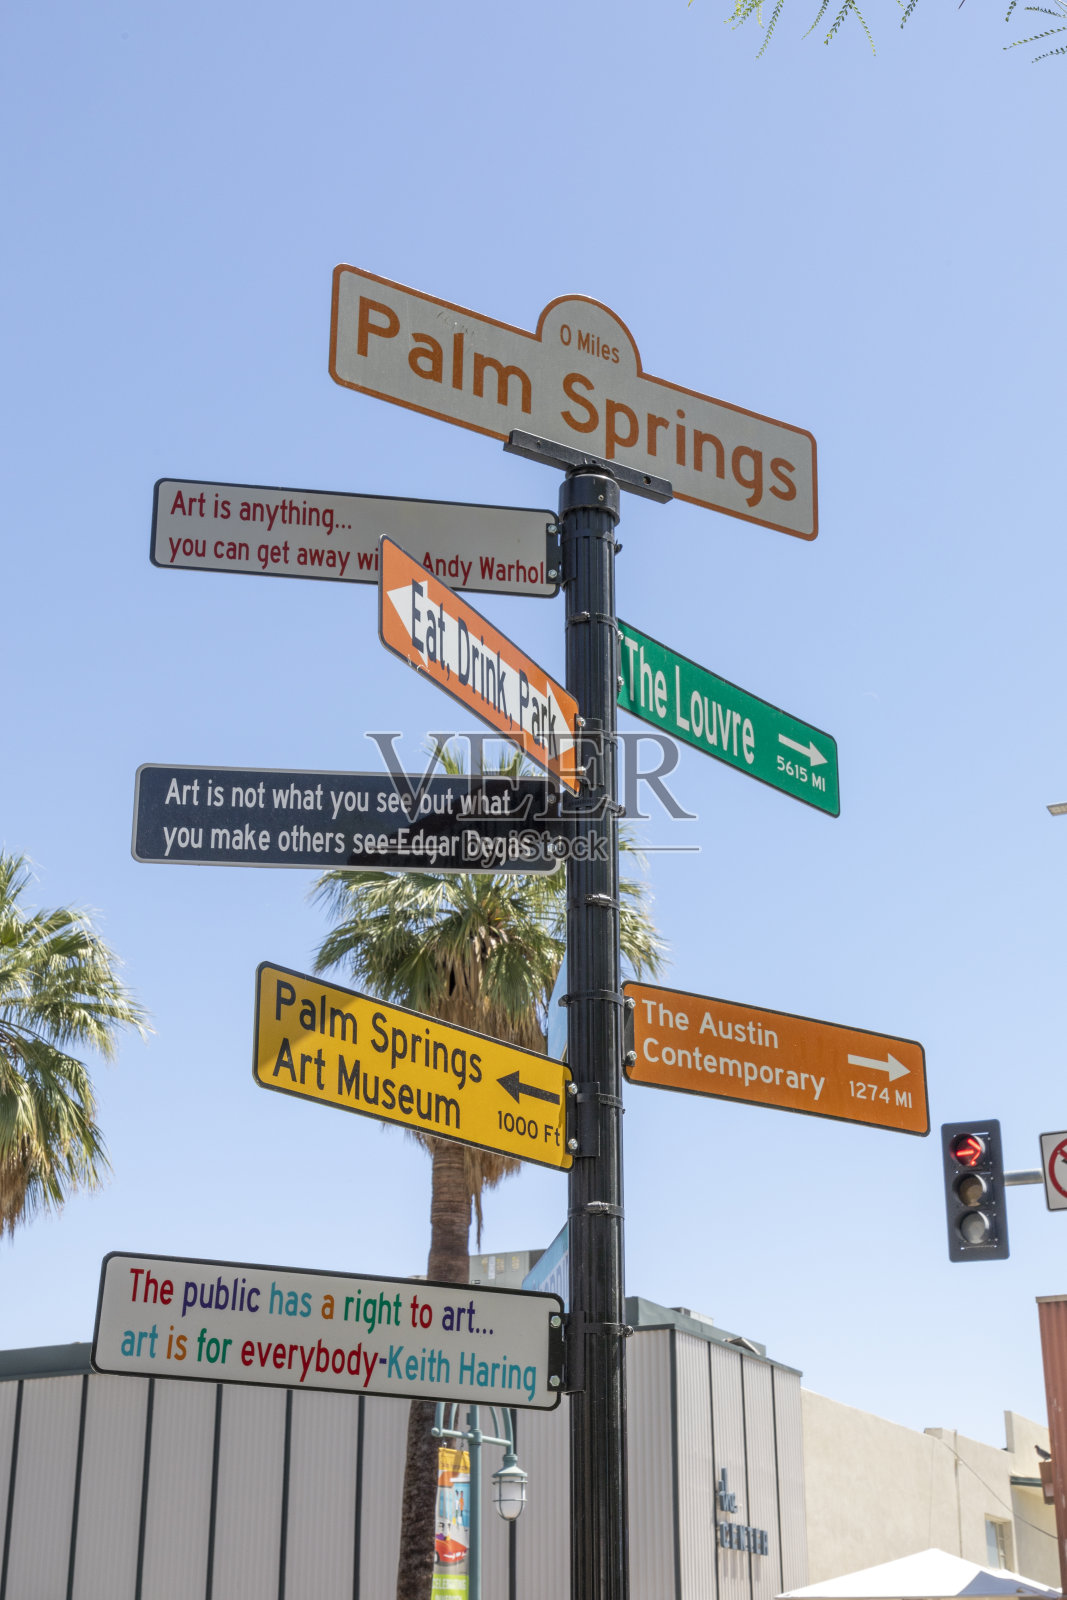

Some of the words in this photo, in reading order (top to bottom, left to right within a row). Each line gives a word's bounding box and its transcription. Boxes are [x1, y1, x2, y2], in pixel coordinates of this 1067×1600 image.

[577, 330, 620, 364] Miles
[356, 295, 532, 415] Palm
[560, 372, 797, 508] Springs
[170, 490, 206, 518] Art
[214, 494, 231, 520] is
[239, 497, 352, 535] anything...
[169, 535, 206, 562] you
[213, 537, 250, 561] can
[257, 541, 289, 569] get
[297, 546, 351, 576] away
[422, 552, 472, 586] Andy
[479, 556, 545, 585] Warhol
[411, 578, 450, 681] Eat,
[458, 616, 512, 731] Drink,
[519, 669, 558, 761] Park
[625, 636, 668, 718] The
[675, 665, 755, 765] Louvre
[165, 777, 199, 806] Art
[207, 779, 224, 807] is
[231, 781, 265, 808] not
[273, 783, 324, 811] what
[331, 790, 369, 819] you
[377, 792, 412, 814] see
[421, 787, 453, 815] but
[460, 788, 511, 816] what
[777, 755, 808, 782] 5615
[812, 772, 826, 792] MI
[164, 826, 203, 856] you
[210, 823, 270, 851] make
[278, 824, 345, 853] others
[467, 830, 531, 866] Degas
[276, 980, 358, 1045] Palm
[371, 1012, 482, 1090] Springs
[642, 999, 689, 1031] The
[699, 1012, 779, 1049] Austin
[273, 1038, 325, 1090] Art
[338, 1055, 461, 1129] Museum
[643, 1038, 825, 1100] Contemporary
[849, 1081, 889, 1104] 1274
[895, 1090, 913, 1108] MI
[498, 1110, 538, 1139] 1000
[545, 1124, 560, 1147] Ft
[130, 1268, 173, 1305] The
[182, 1271, 260, 1317] public
[270, 1281, 312, 1317] has
[321, 1294, 334, 1320] a
[344, 1288, 402, 1333] right
[410, 1300, 433, 1329] to
[442, 1300, 494, 1336] art...
[120, 1324, 159, 1359] art
[166, 1325, 187, 1360] is
[197, 1328, 232, 1364] for
[459, 1352, 536, 1402] Haring
[720, 1522, 768, 1556] CENTER
